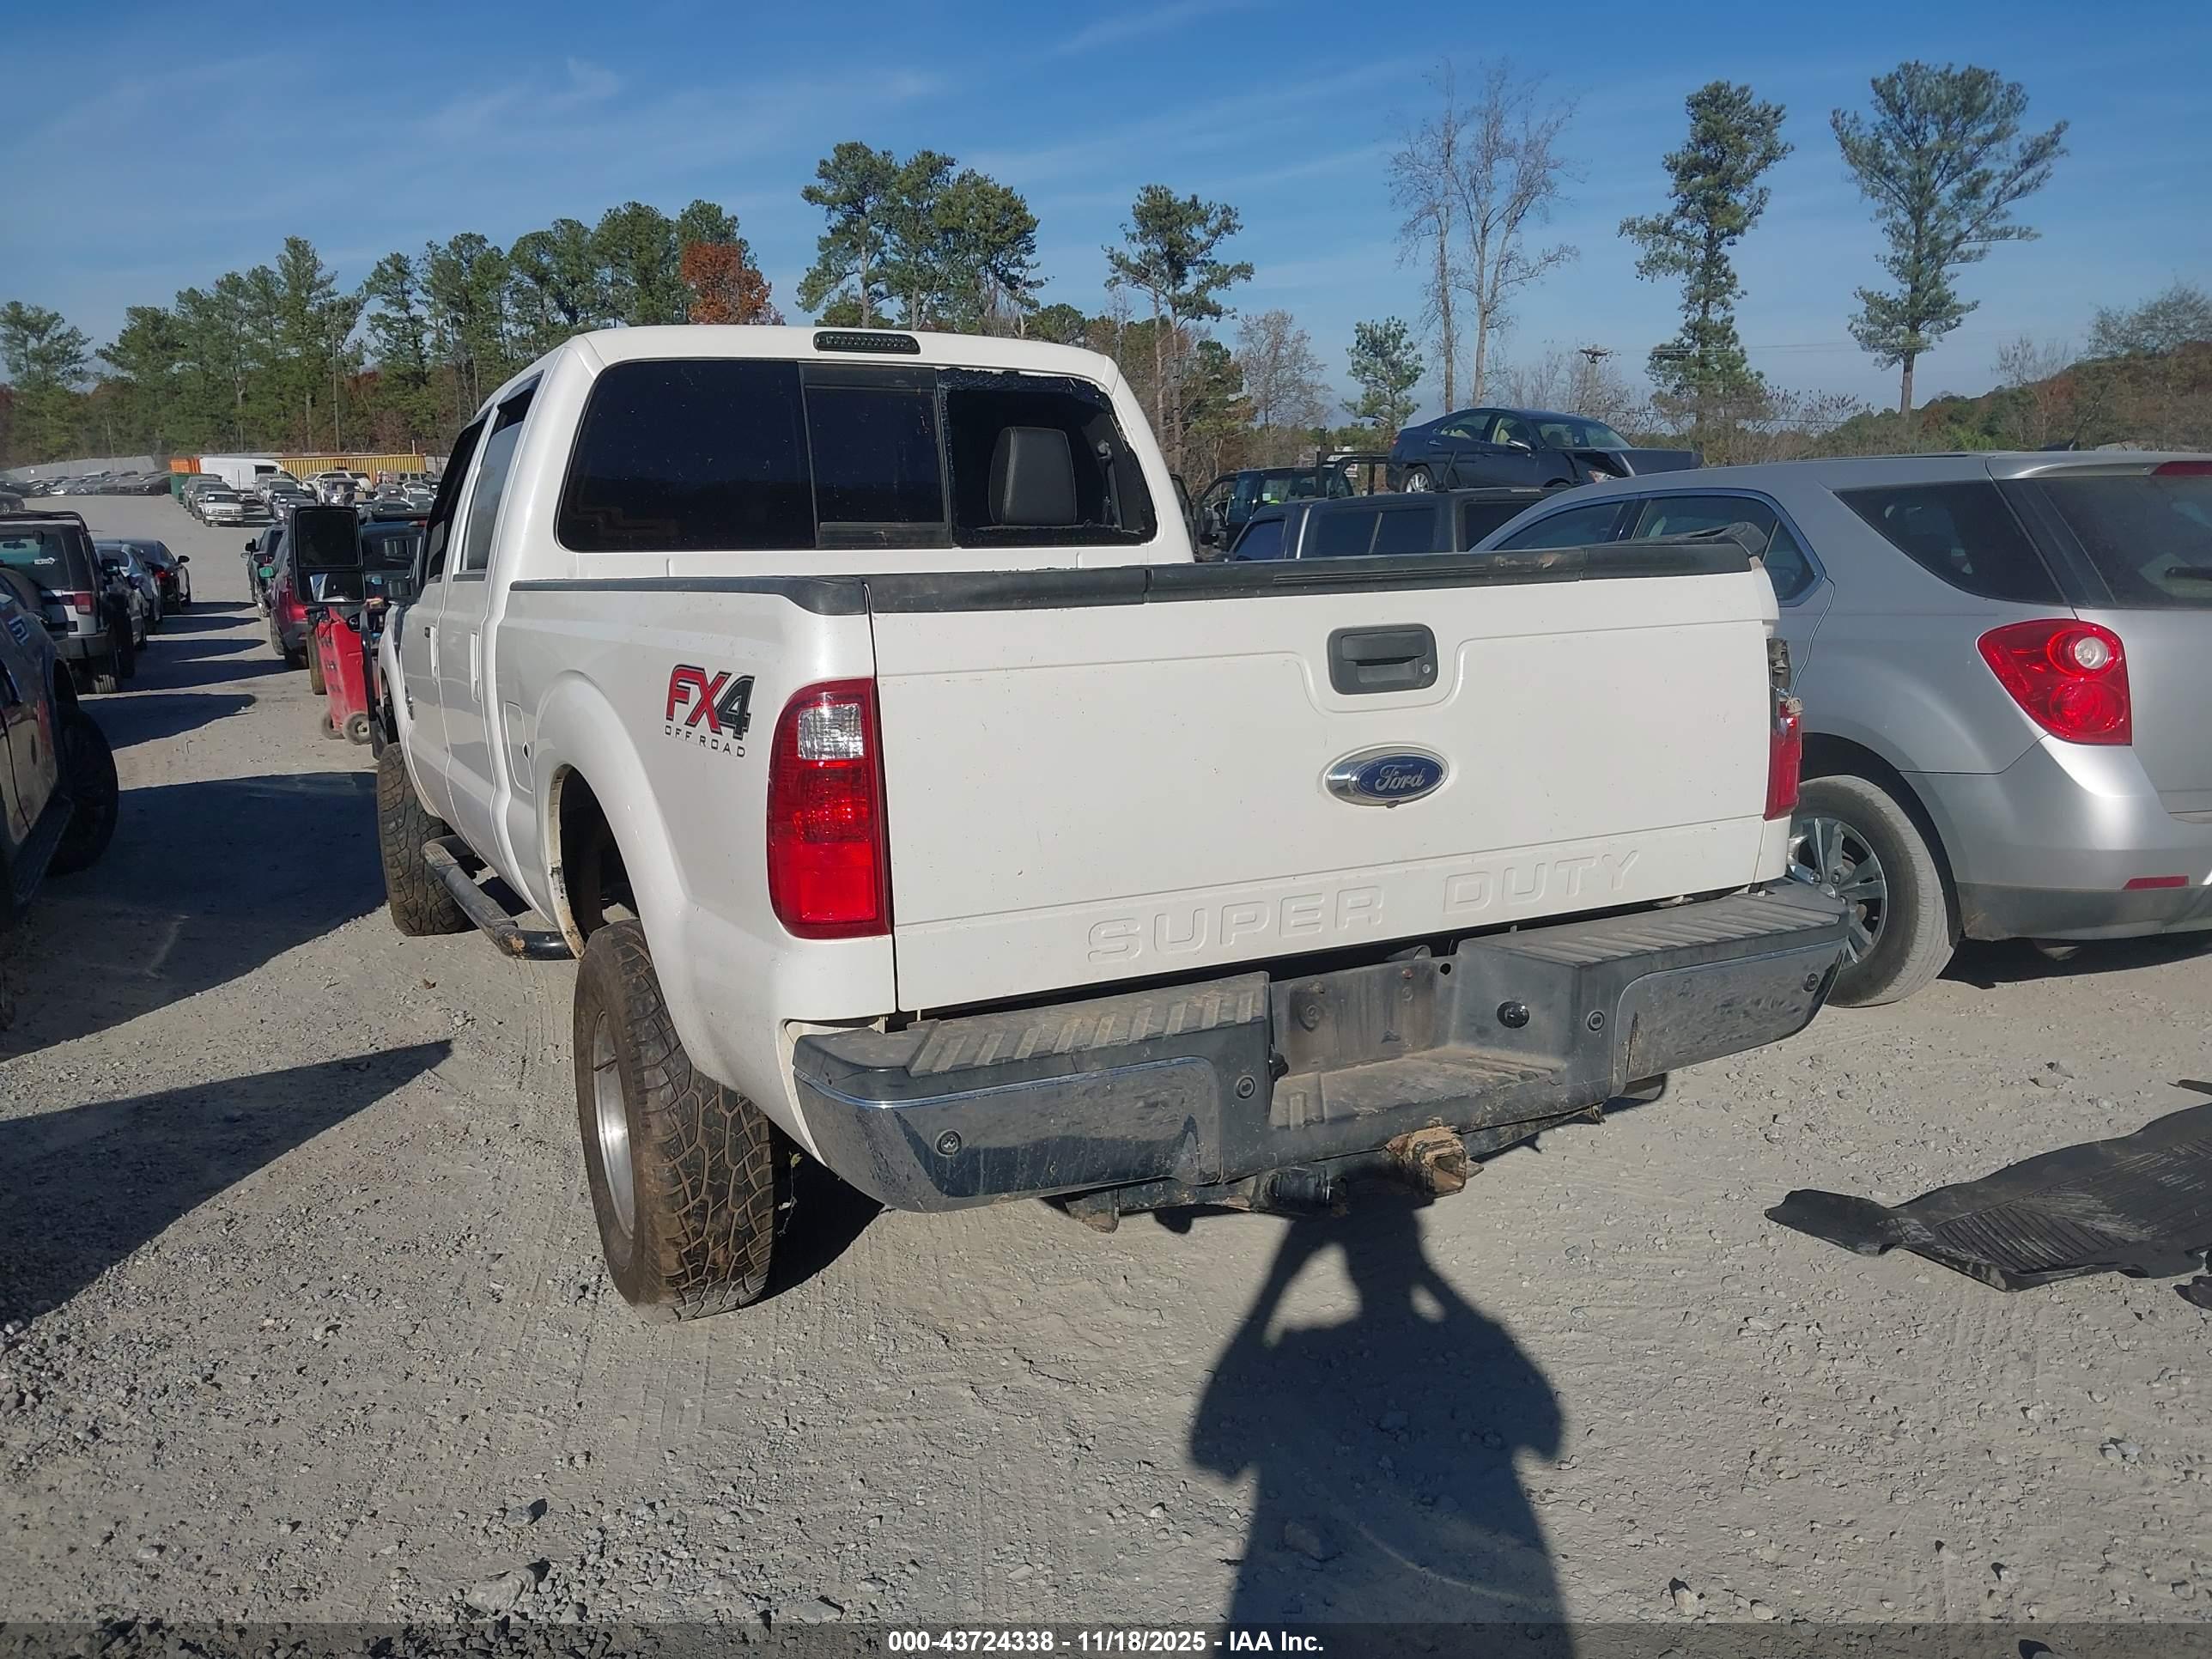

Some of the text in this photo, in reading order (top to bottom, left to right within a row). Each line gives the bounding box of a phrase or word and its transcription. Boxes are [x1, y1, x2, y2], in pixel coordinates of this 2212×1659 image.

[665, 664, 756, 740] FX4
[665, 725, 746, 757] OFF ROAD
[1374, 763, 1426, 792] Ford
[1087, 849, 1640, 964] SUPER DUTY
